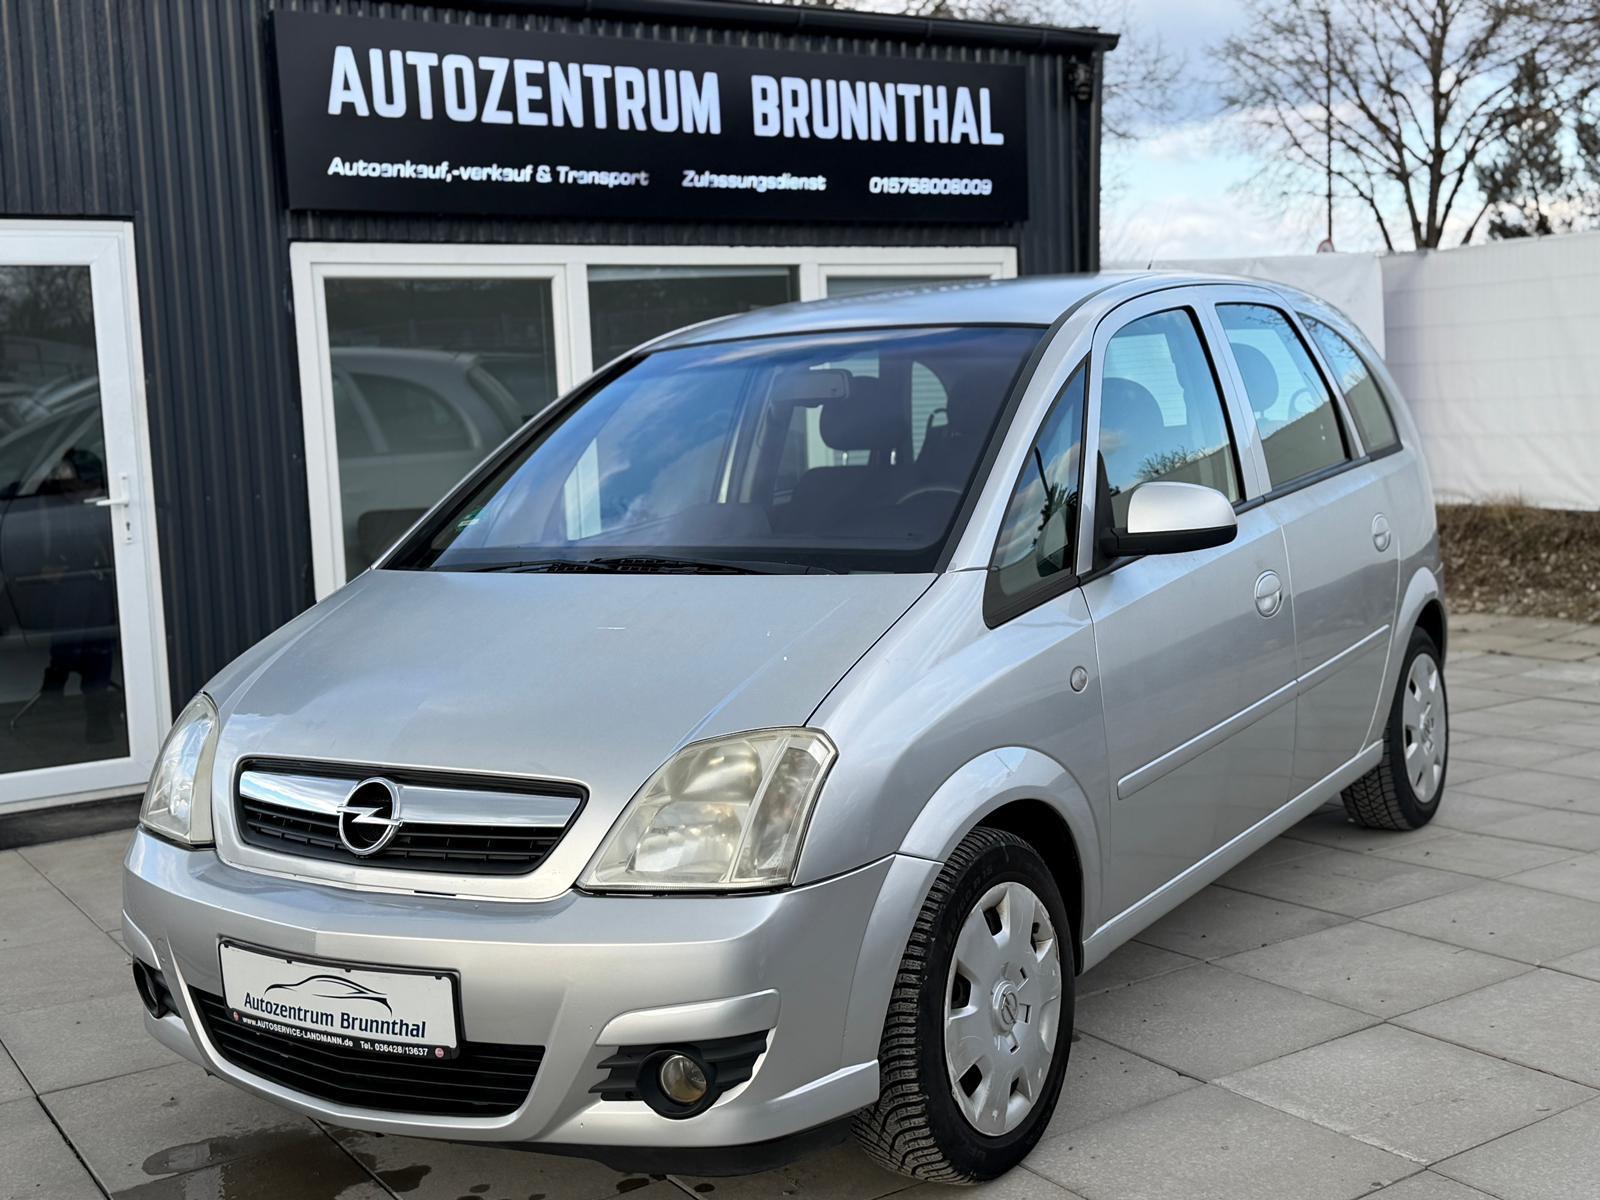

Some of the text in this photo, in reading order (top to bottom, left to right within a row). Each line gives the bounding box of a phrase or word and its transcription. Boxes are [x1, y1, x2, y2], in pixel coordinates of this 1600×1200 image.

[328, 46, 1004, 146] AUTOZENTRUM BRUNNTHAL
[536, 165, 553, 184] &
[556, 166, 649, 189] Transport
[681, 170, 827, 193] Zulassungsdienst
[244, 992, 426, 1038] Autozentrum Brunnthal
[242, 1017, 353, 1047] www.AUTOSERVICE-LANDMANN.de
[360, 1041, 374, 1050] Tel.
[374, 1043, 428, 1056] 036428/13637
